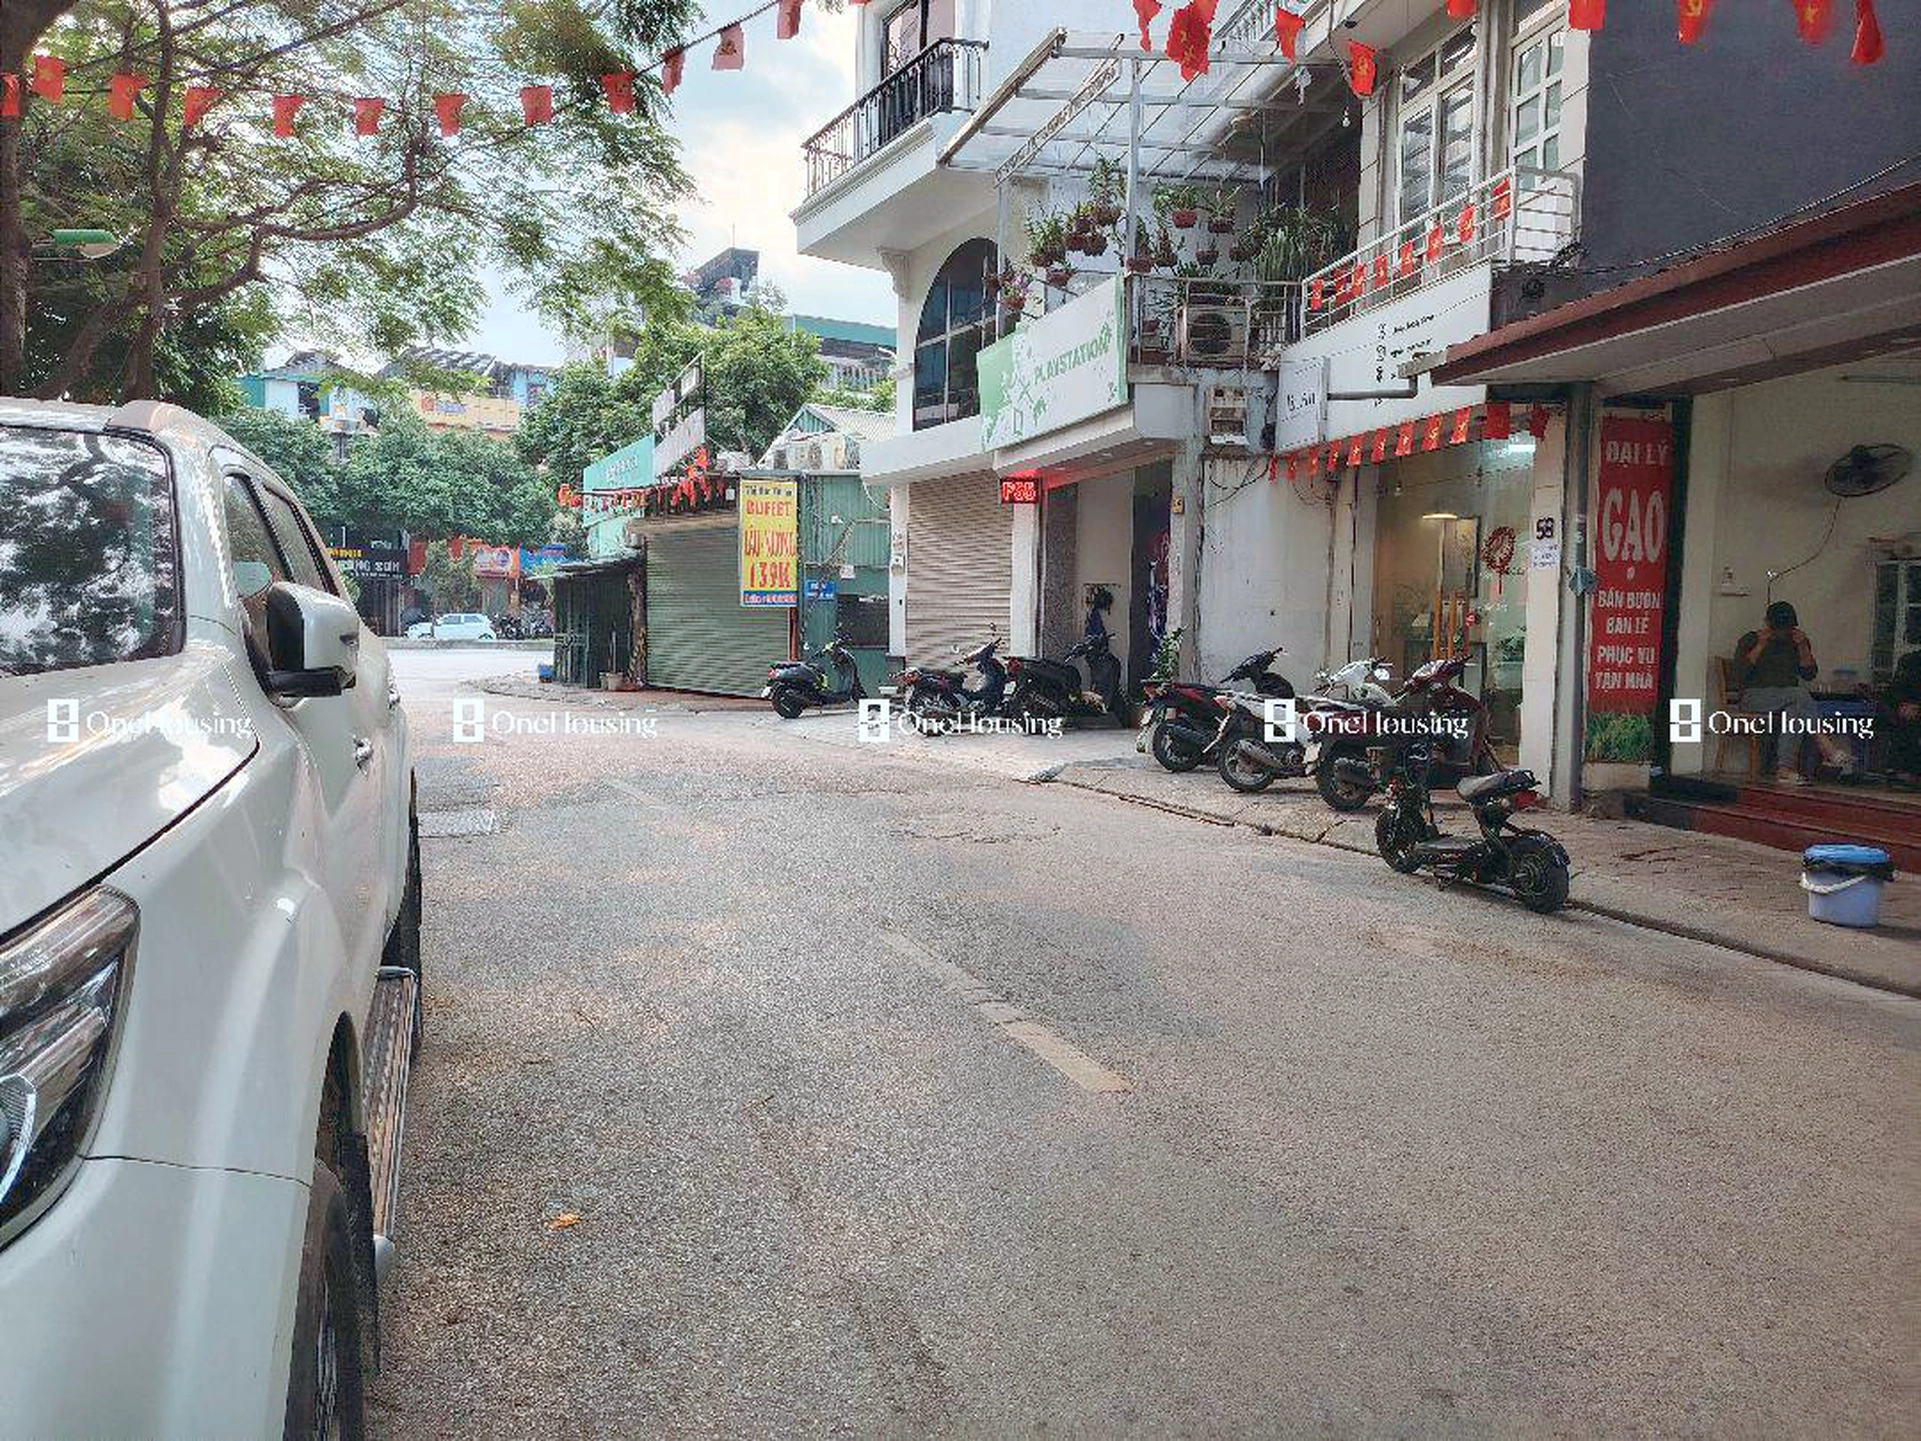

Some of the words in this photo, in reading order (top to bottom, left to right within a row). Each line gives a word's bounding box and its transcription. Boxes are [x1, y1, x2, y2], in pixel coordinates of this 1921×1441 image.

[1602, 486, 1665, 580] GẠO
[1598, 586, 1623, 609] BÁN
[1597, 645, 1634, 668] PHỤC
